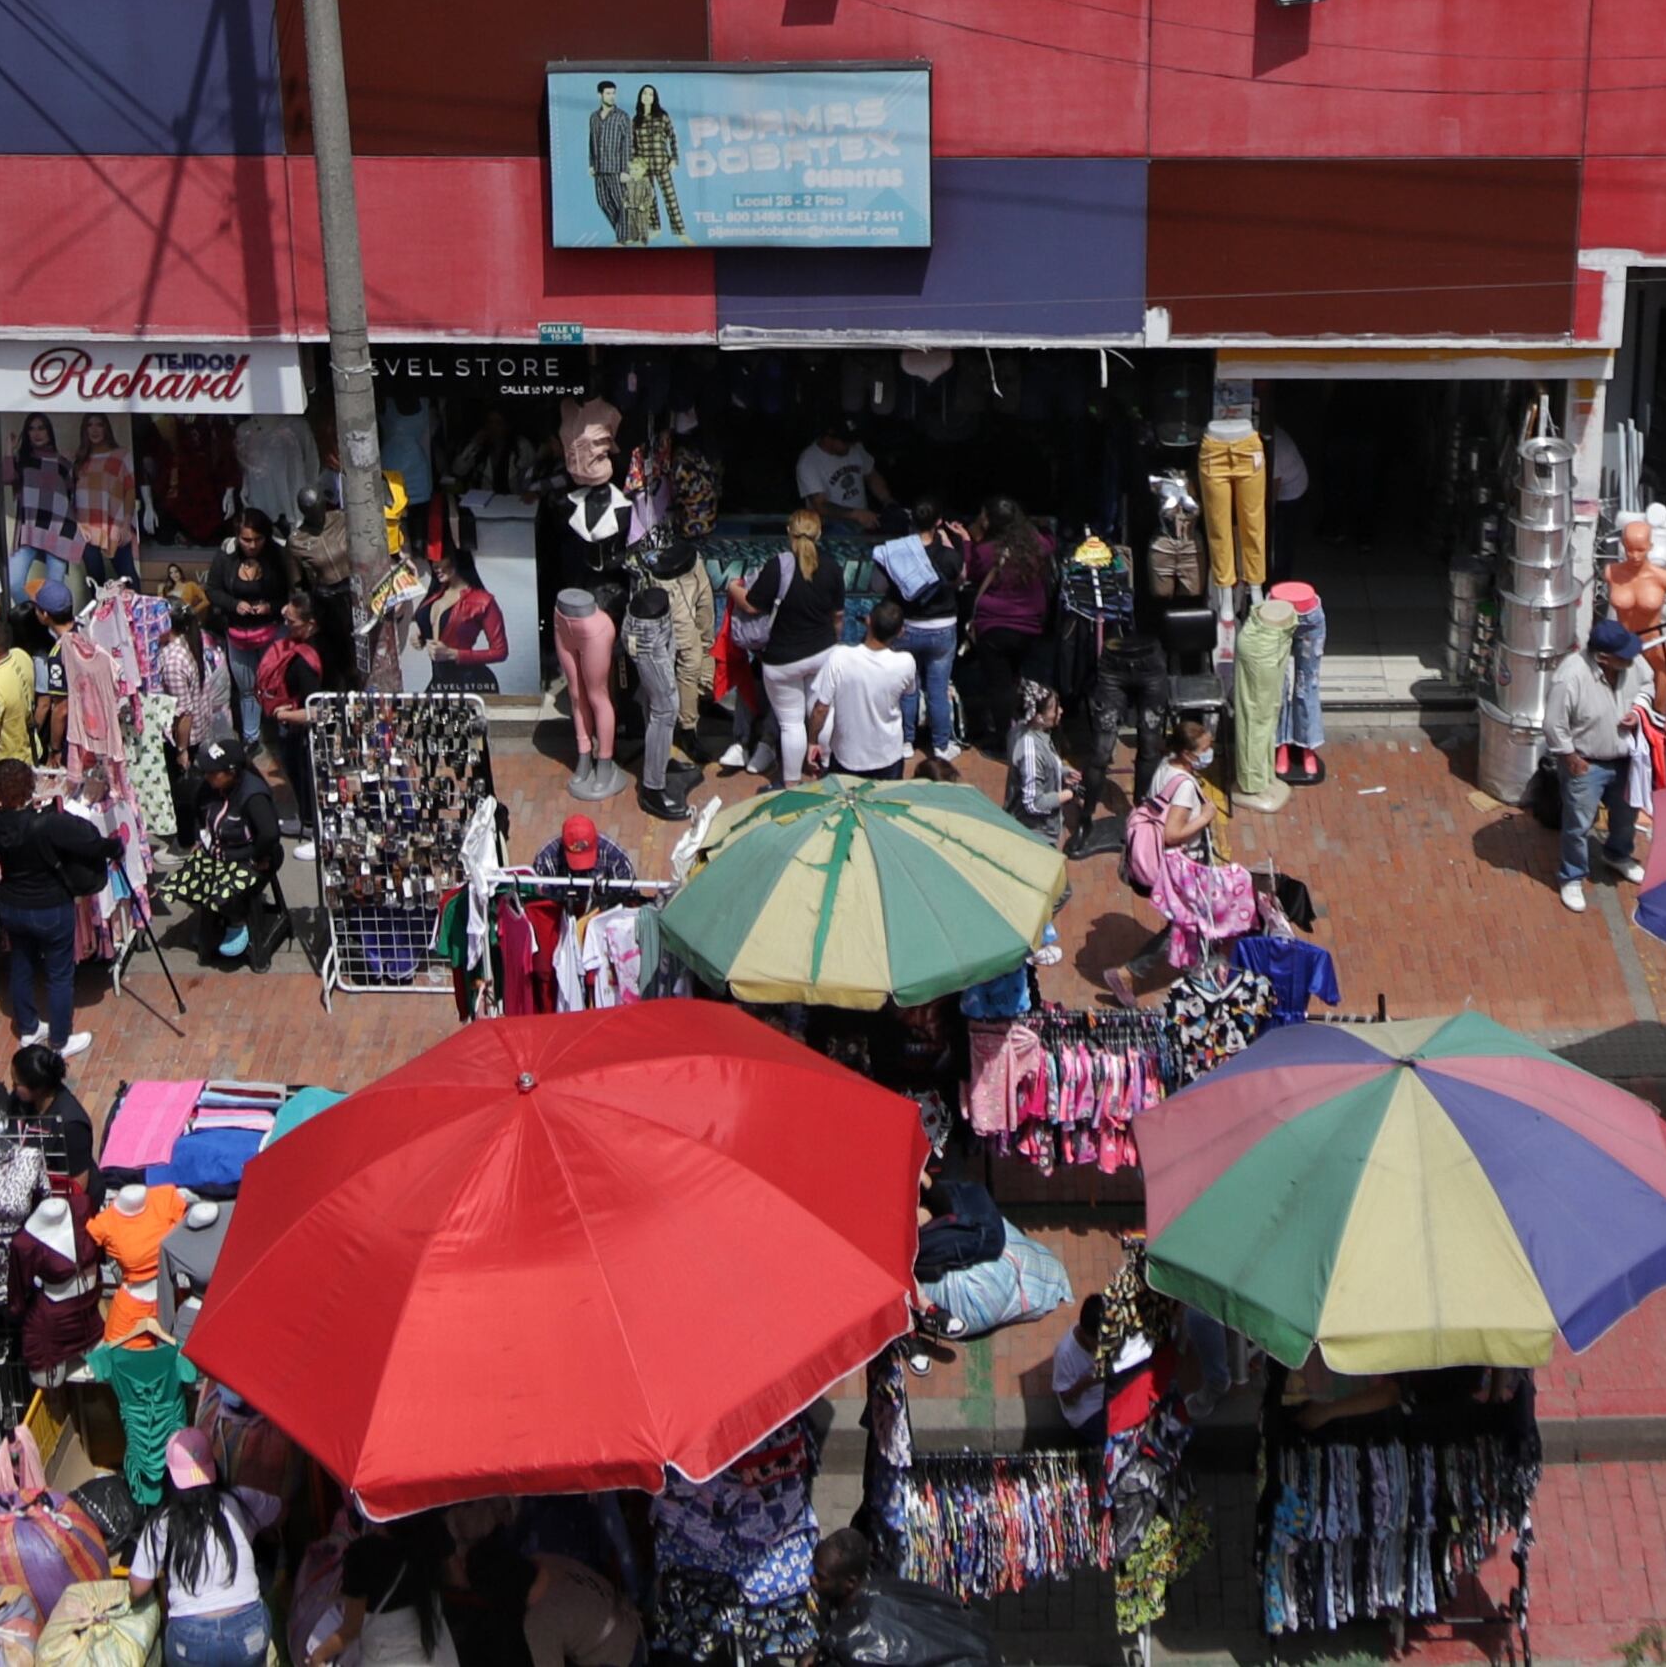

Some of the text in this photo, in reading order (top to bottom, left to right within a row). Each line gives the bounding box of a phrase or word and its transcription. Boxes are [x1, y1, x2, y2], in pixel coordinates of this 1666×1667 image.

[688, 97, 886, 149] PIJAMAS
[685, 129, 901, 179] DOBATEX
[735, 195, 774, 208] Local
[815, 195, 845, 207] Piso
[694, 211, 723, 223] TEL:
[786, 211, 818, 223] CEL:
[541, 325, 581, 334] CALLE 10
[154, 353, 237, 372] TEJIDOS
[455, 358, 560, 376] STORE
[29, 346, 250, 402] Richard
[500, 385, 530, 395] CALLE
[430, 683, 496, 691] LEVEL STORE
